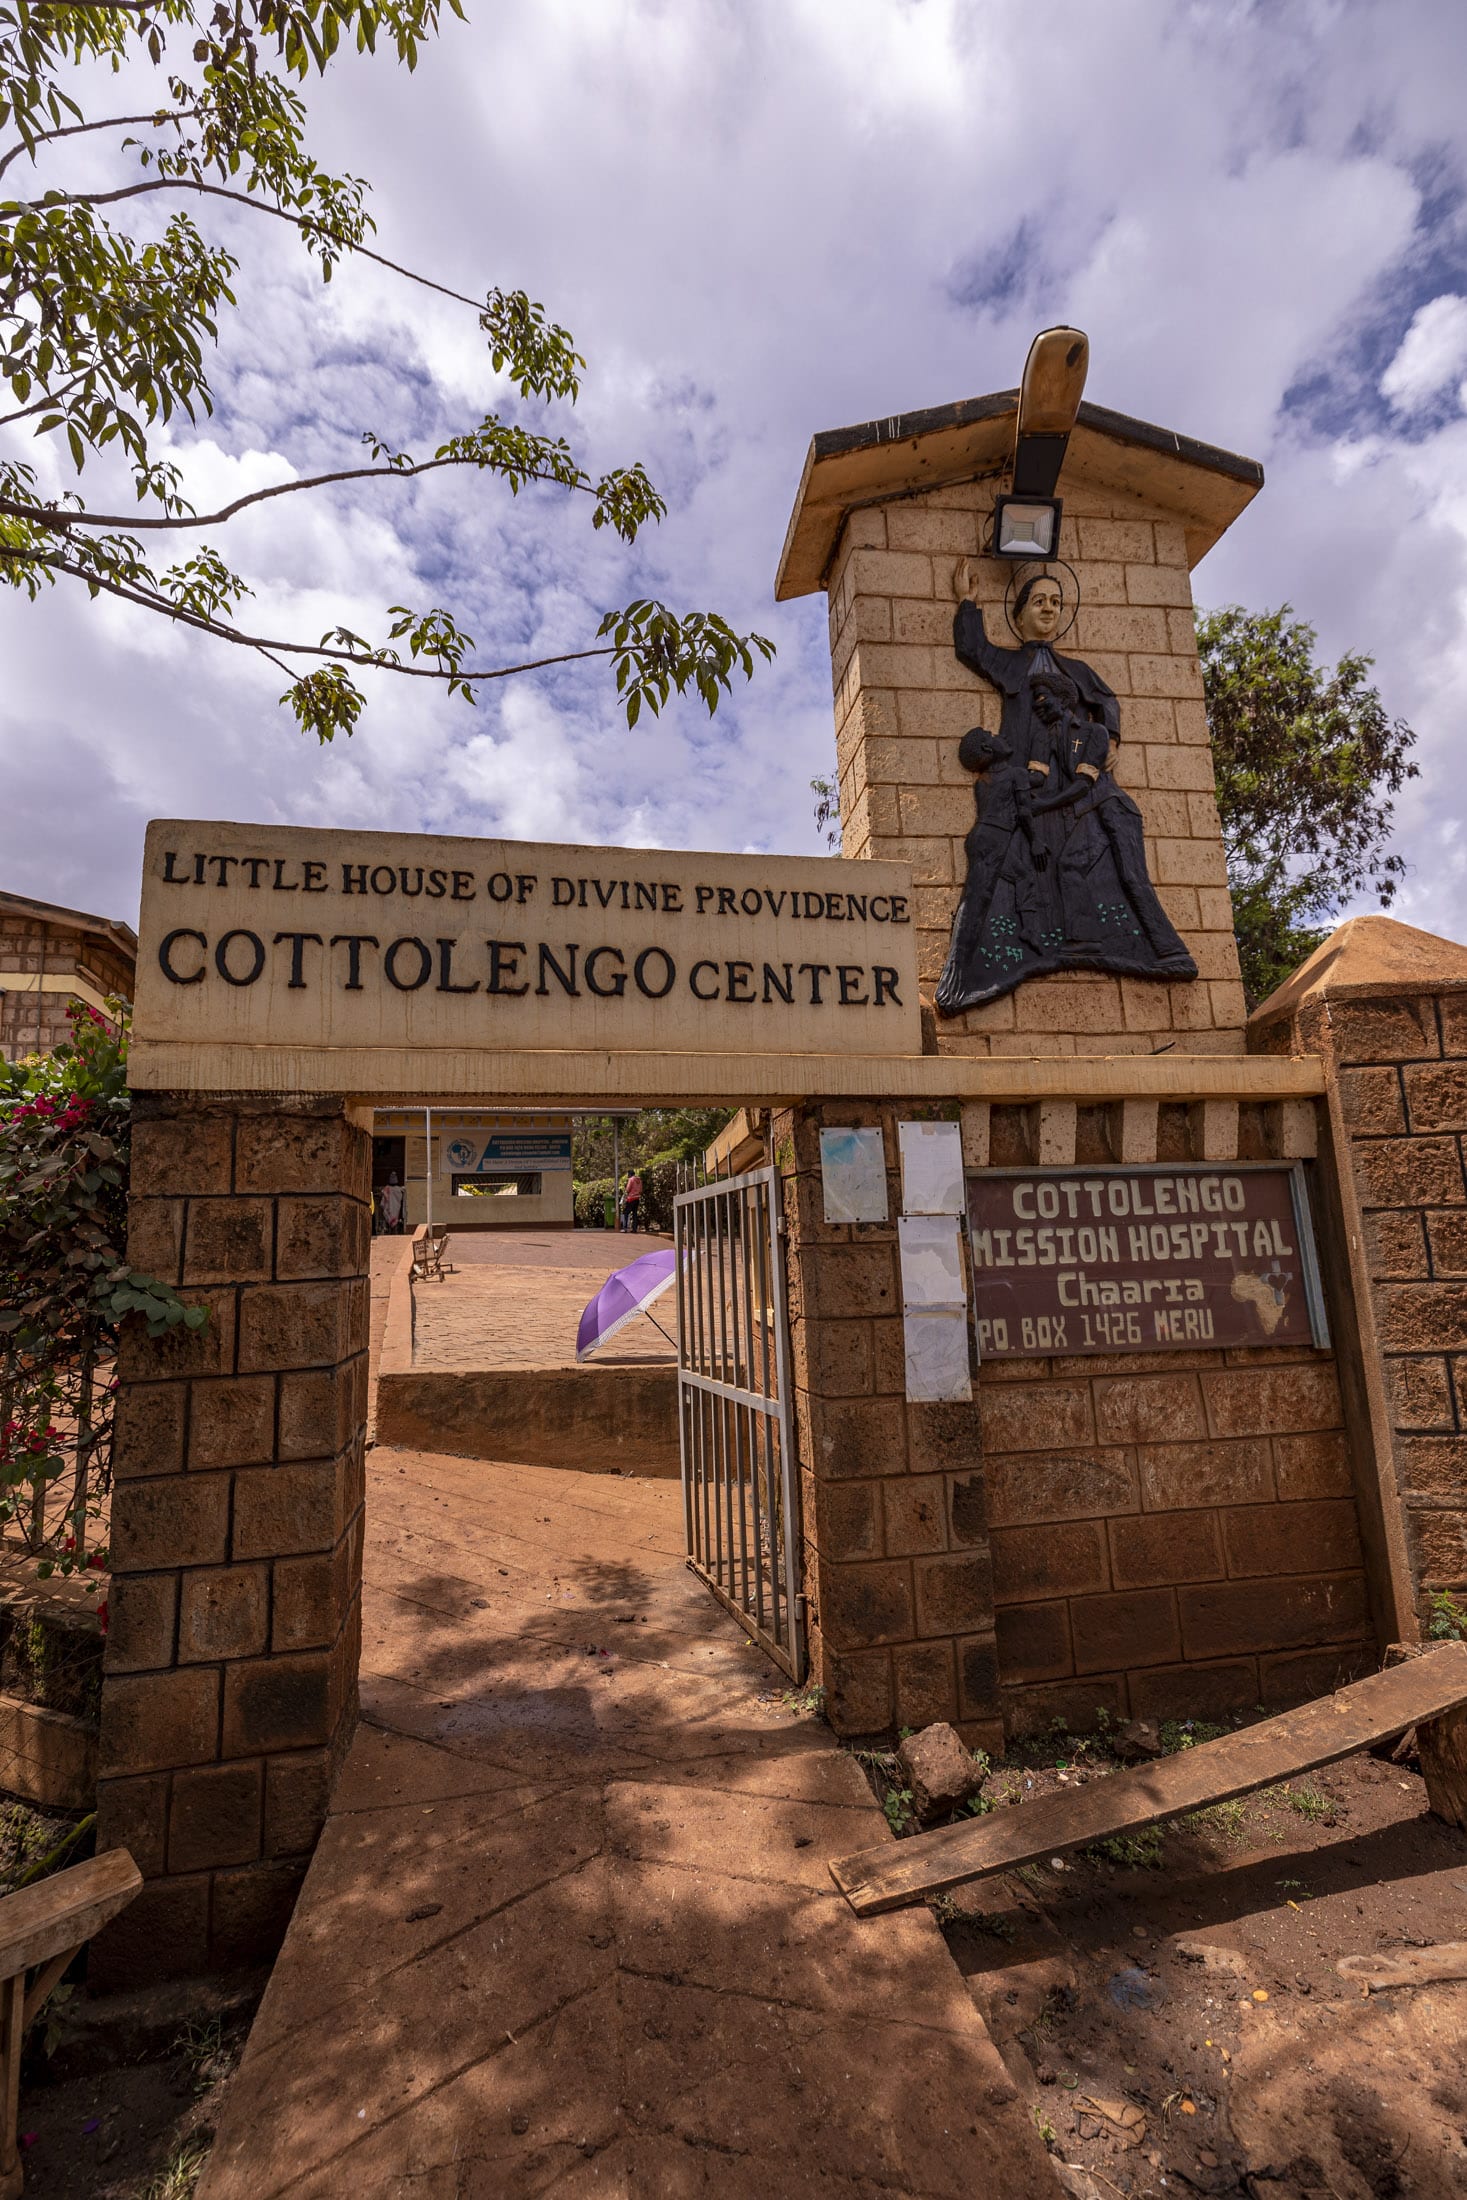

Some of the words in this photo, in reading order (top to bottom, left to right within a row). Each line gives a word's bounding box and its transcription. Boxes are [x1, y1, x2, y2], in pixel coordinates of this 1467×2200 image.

[163, 852, 329, 891] LITTLE
[342, 864, 476, 900] HOUSE
[488, 872, 538, 904] OF
[551, 877, 684, 912] DIVINE
[695, 886, 910, 923] PROVIDENCE
[159, 928, 676, 999] COTTOLENGO
[689, 960, 903, 1006] CENTER
[1012, 1177, 1246, 1220] COTTOLENGO
[972, 1226, 1120, 1267] MISSION
[1129, 1219, 1293, 1262] HOSPITAL
[978, 1318, 1016, 1352] P.O.
[1021, 1315, 1068, 1349] BOX
[1080, 1312, 1142, 1347] 1426
[1154, 1308, 1214, 1342] MERU
